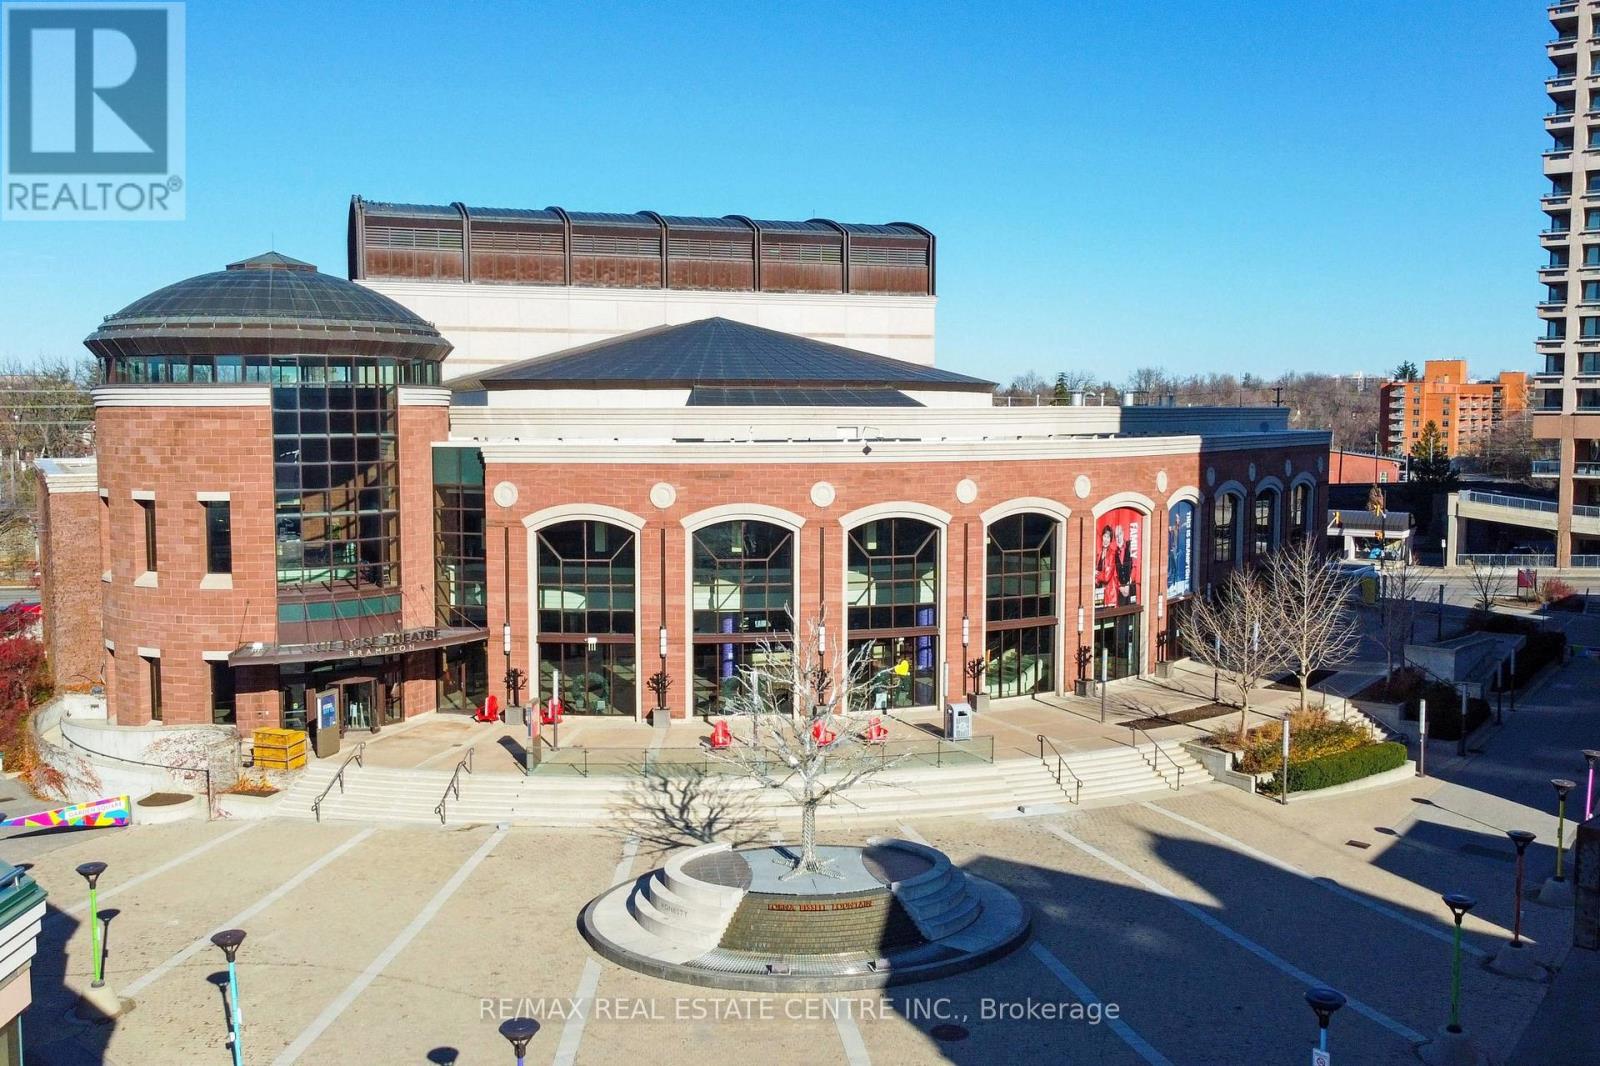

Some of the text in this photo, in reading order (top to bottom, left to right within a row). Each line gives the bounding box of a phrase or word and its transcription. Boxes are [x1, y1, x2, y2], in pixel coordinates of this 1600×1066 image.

[1130, 522, 1138, 558] FAMILY
[343, 636, 380, 650] ROSE
[384, 629, 441, 645] THEATRE
[350, 644, 415, 657] BRAMPTON
